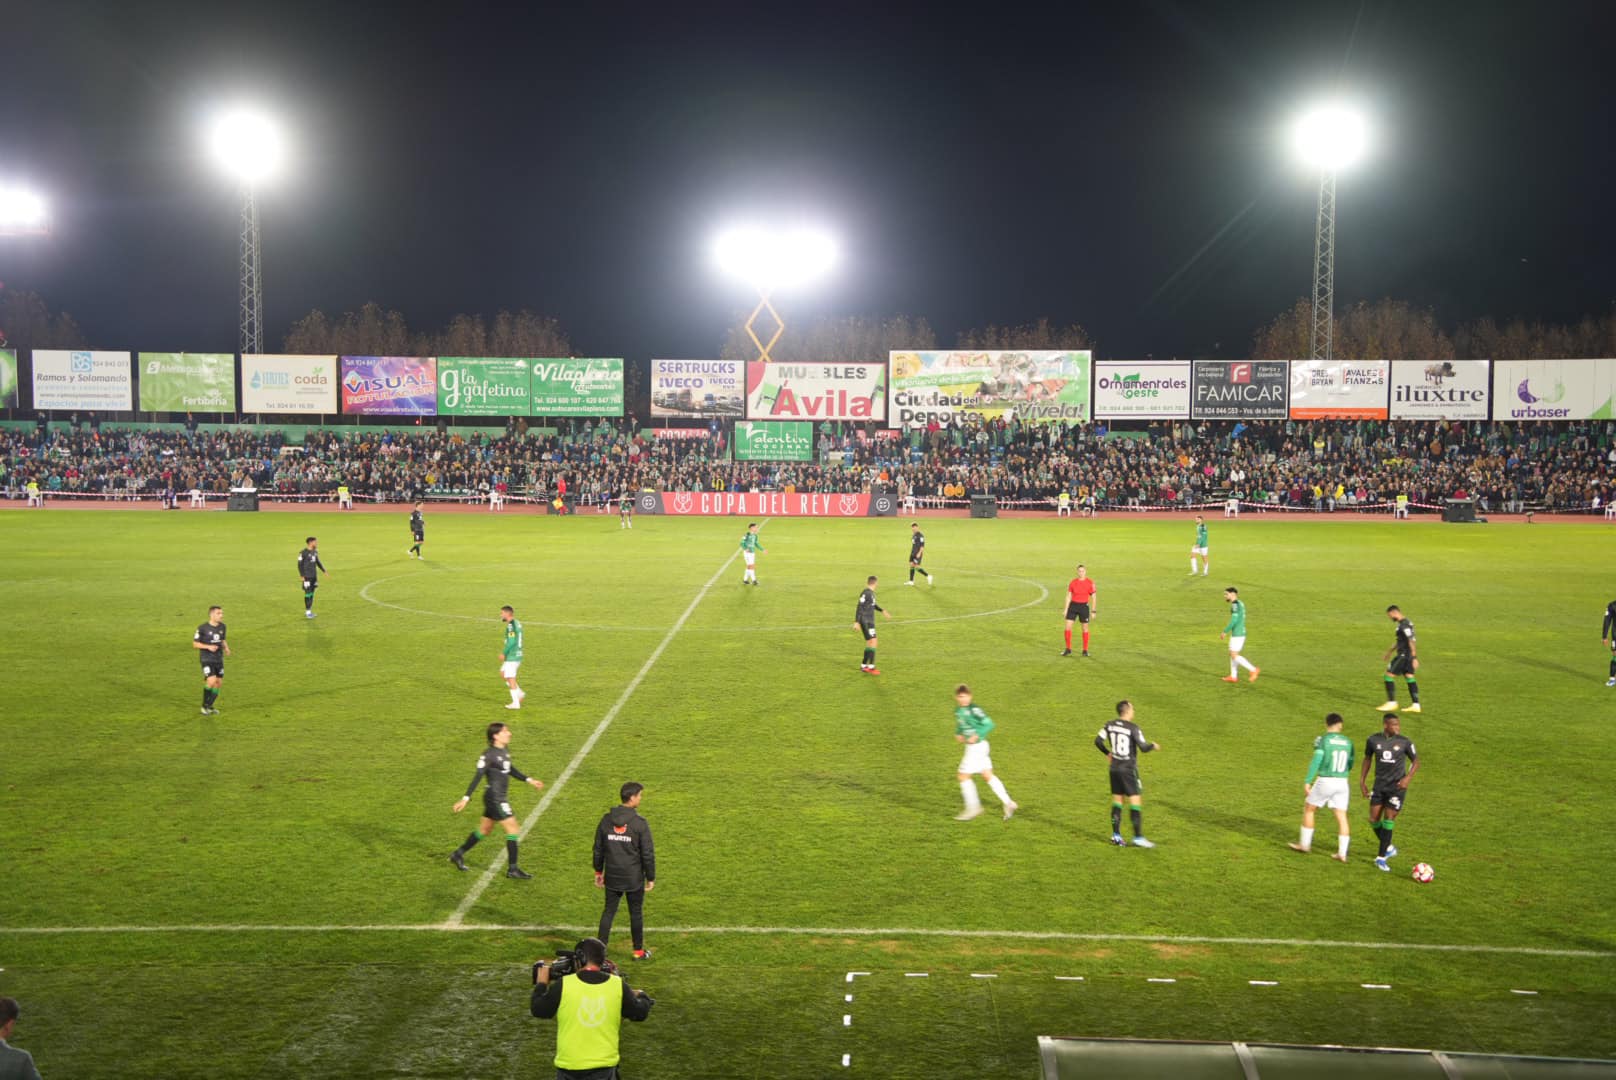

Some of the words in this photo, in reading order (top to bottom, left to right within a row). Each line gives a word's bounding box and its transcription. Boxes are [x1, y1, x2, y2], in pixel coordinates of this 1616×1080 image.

[659, 362, 736, 374] SERTRUCKS
[36, 373, 66, 382] Ramos
[69, 375, 75, 383] y
[78, 373, 128, 382] Solomando
[294, 374, 328, 384] coda
[346, 373, 433, 393] VISUAL
[461, 368, 478, 384] la
[659, 377, 704, 388] IVECO
[709, 377, 735, 385] IVECO
[1346, 377, 1384, 385] FIANZAS
[1099, 378, 1187, 390] Ornamentales
[772, 379, 872, 417] Ávila
[895, 391, 962, 406] Ciudad
[963, 396, 978, 404] del
[1198, 385, 1283, 401] FAMICAR
[1395, 385, 1485, 402] iluxtre
[900, 409, 977, 423] Deporte
[1511, 406, 1571, 418] urbaser
[701, 493, 747, 513] COPA
[759, 493, 789, 514] DEL
[800, 493, 830, 514] REY
[1109, 732, 1130, 756] 18
[1331, 749, 1348, 773] 10
